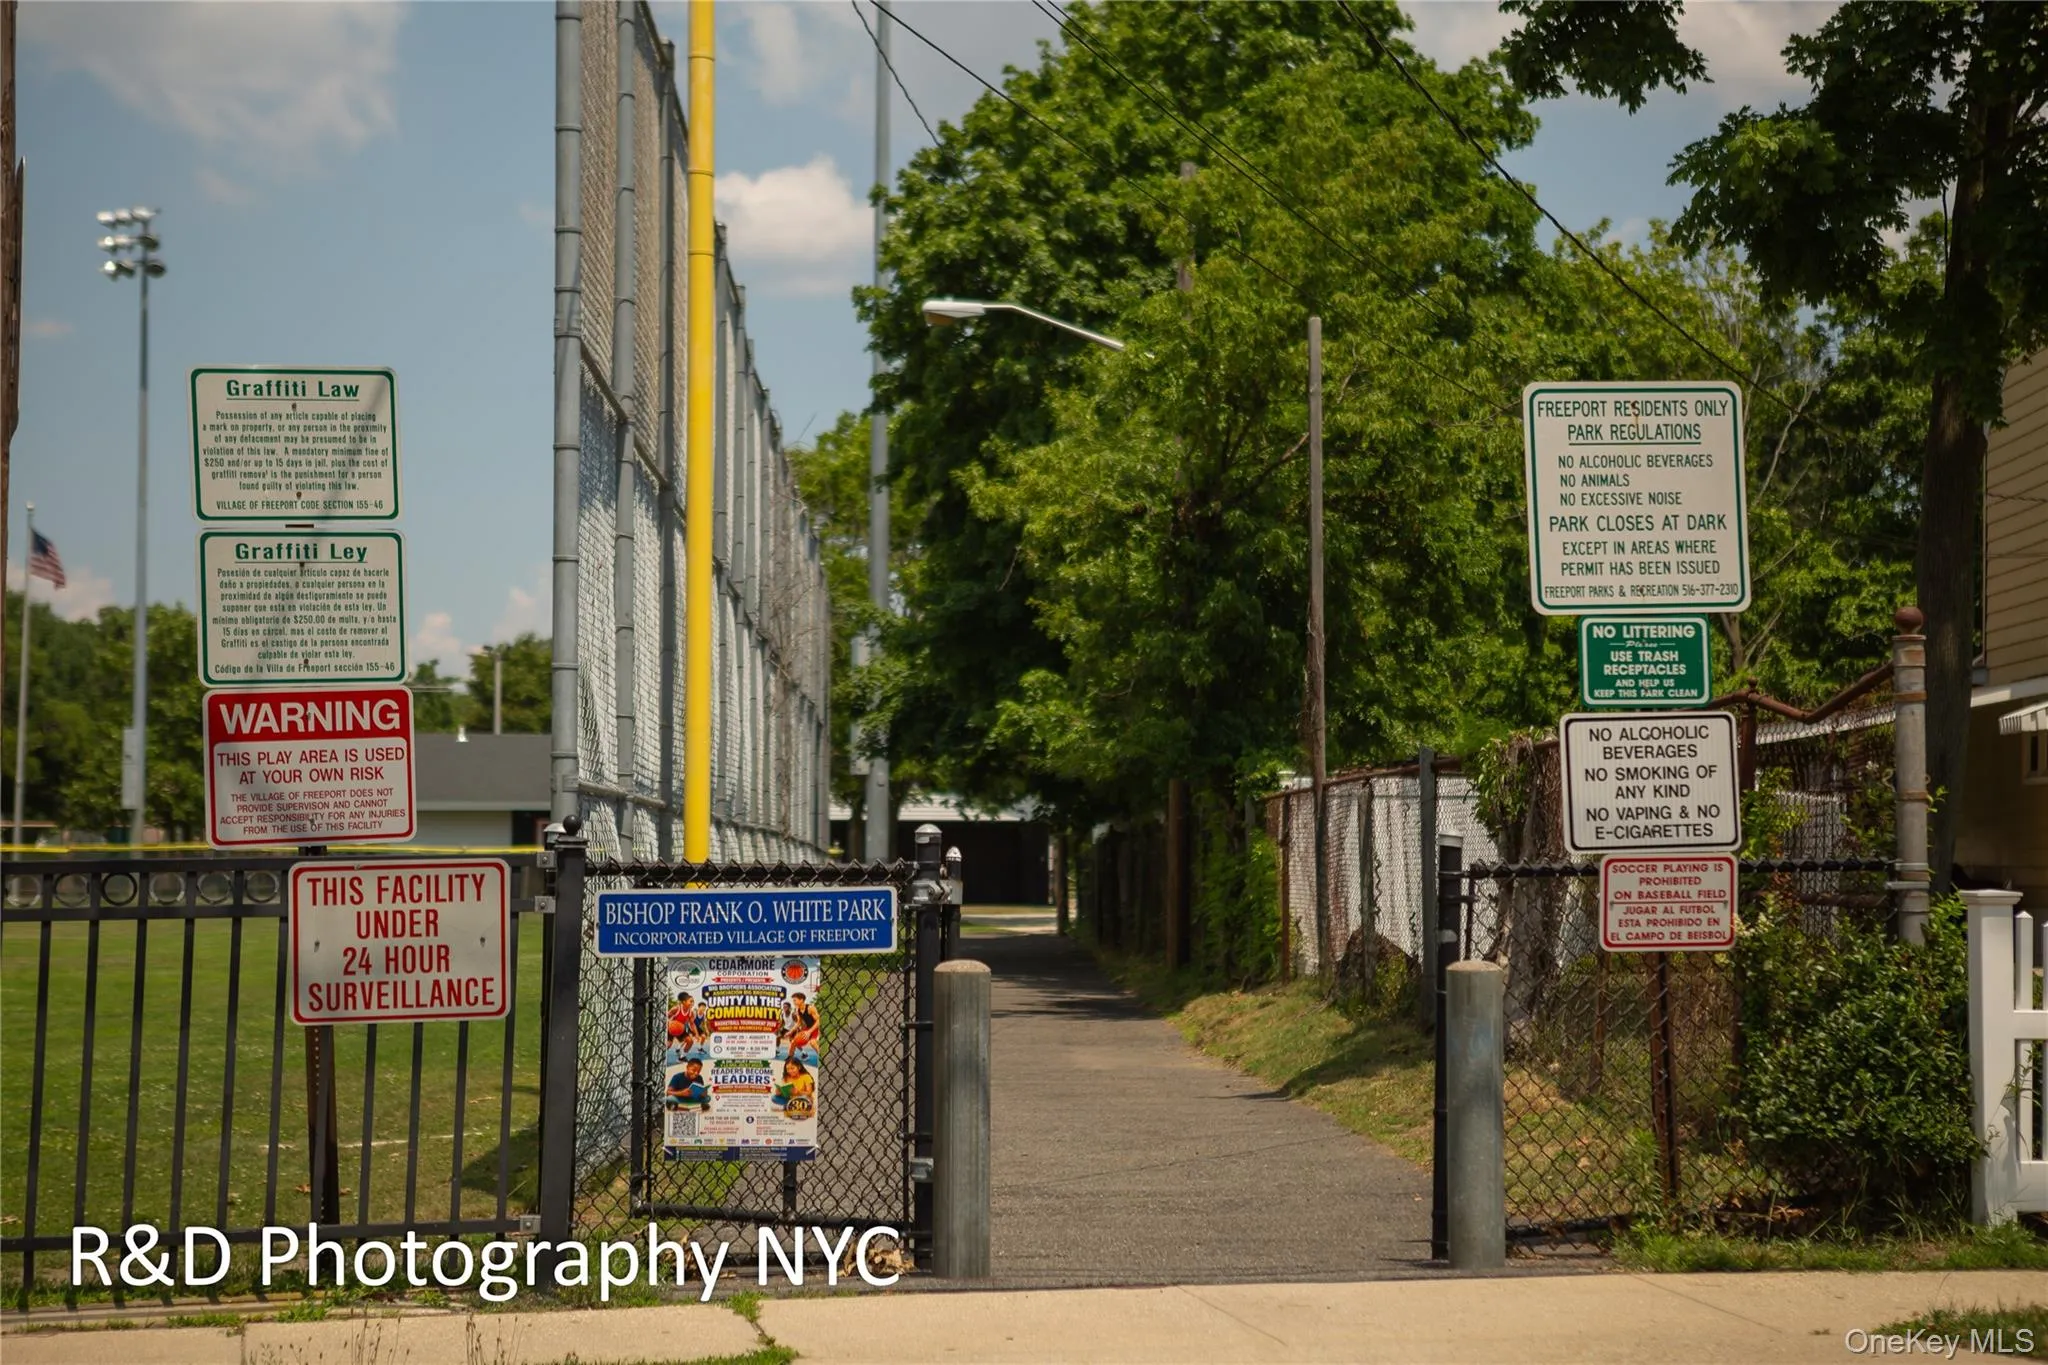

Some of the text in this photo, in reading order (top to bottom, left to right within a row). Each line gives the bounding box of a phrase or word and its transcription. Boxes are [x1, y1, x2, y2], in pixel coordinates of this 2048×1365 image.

[226, 380, 359, 398] Graffiti Law
[1538, 400, 1728, 417] FREEPORT RESIDENTS ONLY
[1568, 424, 1701, 440] PARK REGULATIONS
[1558, 454, 1713, 468] NO ALCOHOLIC BEVERAGES
[1560, 474, 1629, 487] NO ANIMALS
[217, 500, 383, 510] VILLAGE OF FREEPORT CODE SECTION 155-46
[1560, 492, 1682, 506] NO EXCESSIVE NOISE
[1550, 514, 1727, 532] PARK CLOSES AT DARK
[235, 543, 367, 562] Graffiti Ley
[1563, 540, 1717, 555] EXCEPT IN AREAS WHERE
[1561, 561, 1720, 576] PERMIT HAS BEEN ISSUED
[1545, 583, 1738, 598] FREEPORT PARKS & RECREATION 516-377-2310
[1592, 625, 1695, 638] NO LITTERING
[258, 650, 355, 660] culpable de violar esta ley.
[1610, 651, 1679, 662] USE TRASH
[1604, 664, 1686, 675] RECEPTACLES
[1616, 679, 1635, 687] AND
[1639, 679, 1659, 687] HELP
[1641, 689, 1664, 697] PARK
[219, 699, 400, 734] WARNING
[1589, 726, 1709, 742] NO ALCOHOLIC
[218, 748, 405, 766] THIS PLAY AREA IS USED
[1603, 744, 1697, 759] BEVERAGES
[239, 767, 384, 785] AT YOUR OWN RISK
[1585, 765, 1717, 782] NO SMOKING OF
[232, 788, 393, 802] THE VILLAGE OF FREEPORT DOES NOT
[1615, 784, 1690, 800] ANY KIND
[237, 800, 388, 813] PROVIDE SUPERVISON AND CANNOT
[1586, 804, 1720, 821] NO VAPING & NO
[221, 809, 405, 824] ACCEPT RESPONSIBILITY FOR ANY INJURIES
[244, 821, 383, 835] FROM THE USE OF THIS FACILITY
[1596, 824, 1713, 840] E-CIGARETTES
[1612, 864, 1657, 873] SOCCER
[1664, 864, 1708, 872] PLAYING
[1640, 877, 1701, 886] PROHIBITED
[307, 874, 485, 906] THIS FACILITY
[1614, 890, 1726, 899] ON BASEBALL FIELD
[605, 898, 886, 925] BISHOP FRANK O. WHITE PARK
[1623, 905, 1715, 915] JUGAR AL FUTBOL
[356, 909, 439, 939] UNDER
[1619, 918, 1720, 927] ESTA PROHIBIDO EN
[615, 928, 877, 945] INCORPORATED VILLAGE OF FREEPORT
[1611, 930, 1726, 941] EL CAMPO DE BEISBOL
[343, 945, 450, 976] 24 HOUR
[709, 959, 775, 970] CEDARMORE
[308, 978, 495, 1012] SURVEILLANCE
[708, 996, 782, 1007] UNITY IN THE
[707, 1007, 781, 1020] COMMUNITY
[714, 1075, 770, 1084] LEADERS
